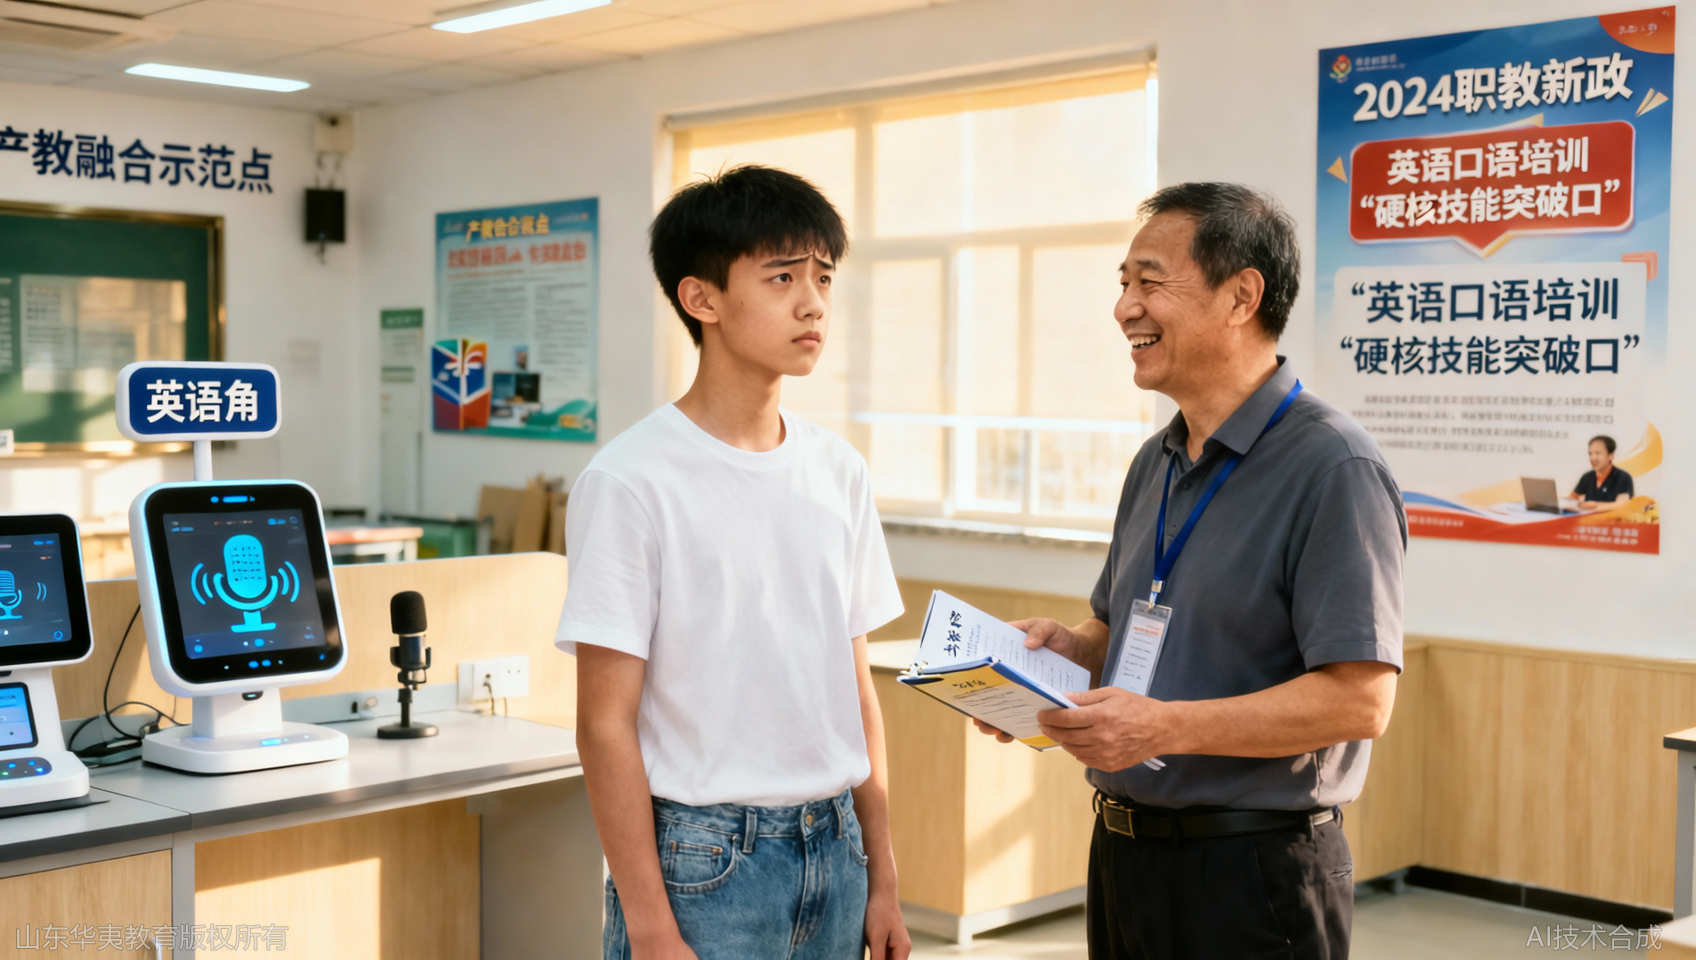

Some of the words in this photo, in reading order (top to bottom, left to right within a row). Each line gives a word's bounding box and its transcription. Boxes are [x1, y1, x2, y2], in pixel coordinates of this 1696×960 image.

[1353, 52, 1634, 122] 2024职教新政
[0, 126, 274, 194] 产教融合示范点
[1387, 136, 1589, 185] 英语口语培训
[1360, 179, 1620, 229] “硬核技能突破口”
[1351, 277, 1619, 323] “英语口语培训
[1340, 334, 1640, 375] “硬核技能突破口”
[146, 379, 259, 424] 英语角
